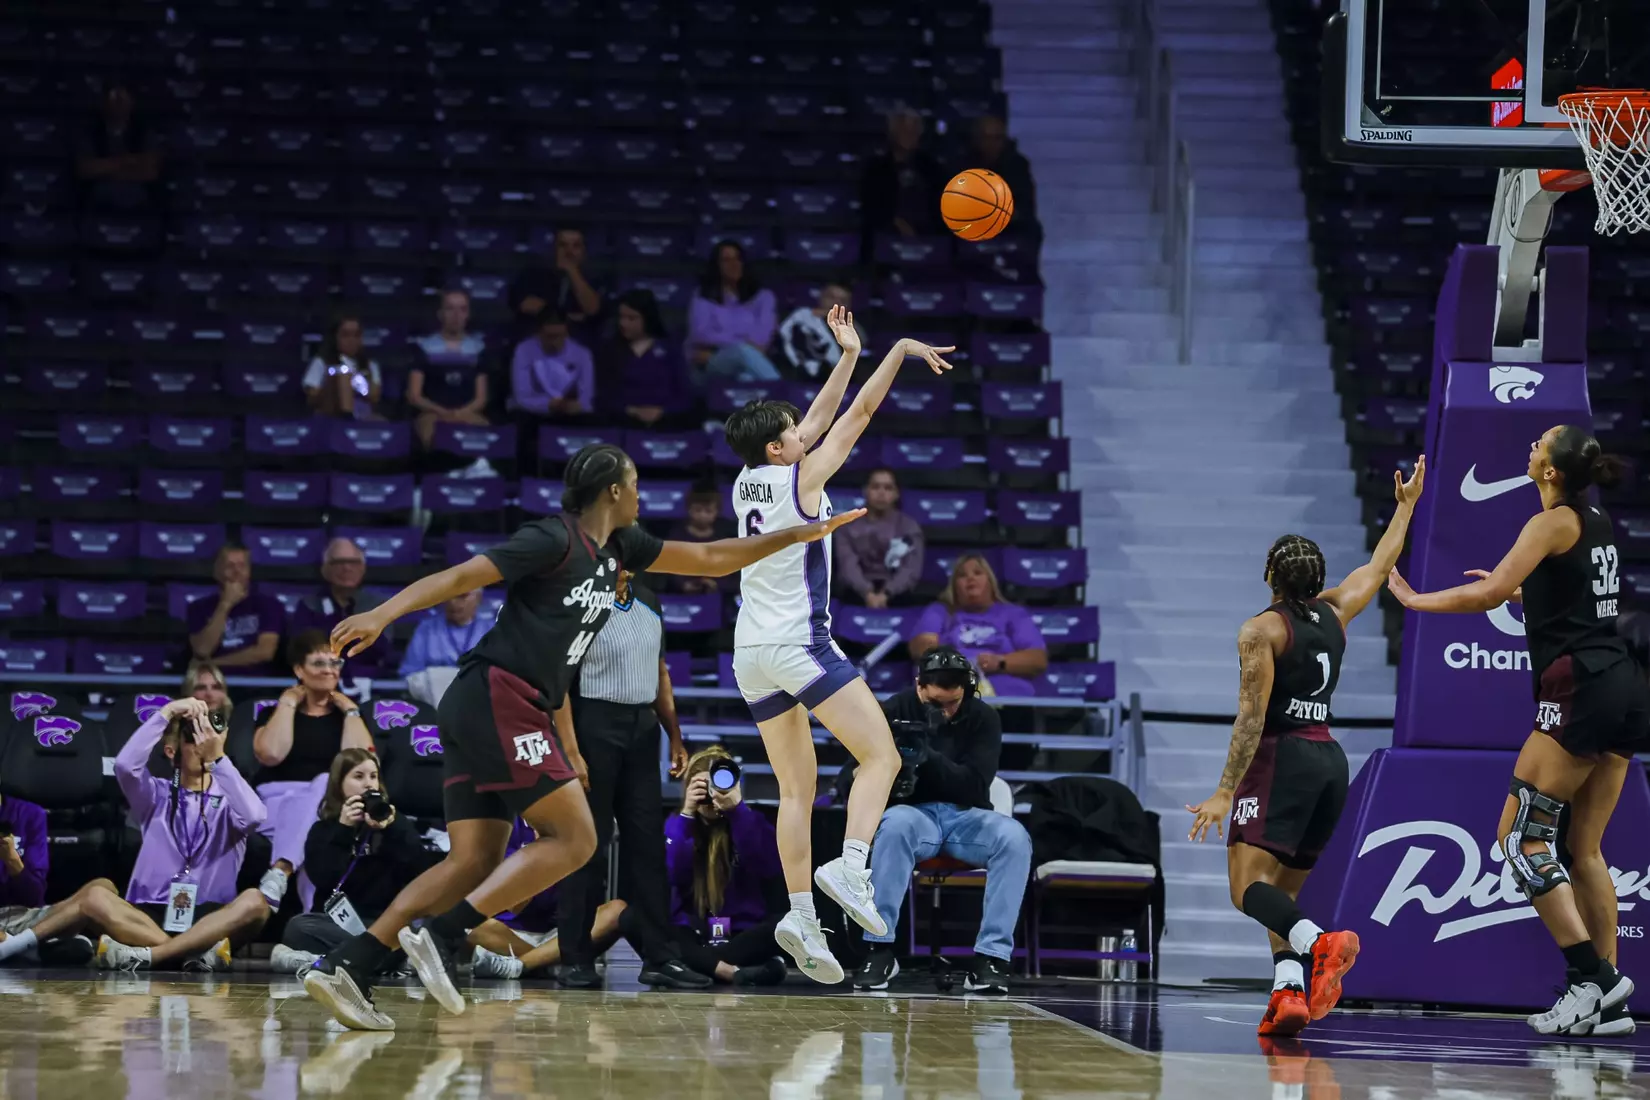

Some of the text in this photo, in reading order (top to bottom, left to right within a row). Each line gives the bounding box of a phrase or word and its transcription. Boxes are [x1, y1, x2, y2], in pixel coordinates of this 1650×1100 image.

[1360, 129, 1413, 142] SPALDING
[740, 482, 773, 504] GARCIA
[1591, 544, 1620, 596] 32
[1596, 598, 1619, 619] WARE
[1309, 652, 1331, 697] 1
[337, 908, 350, 923] M
